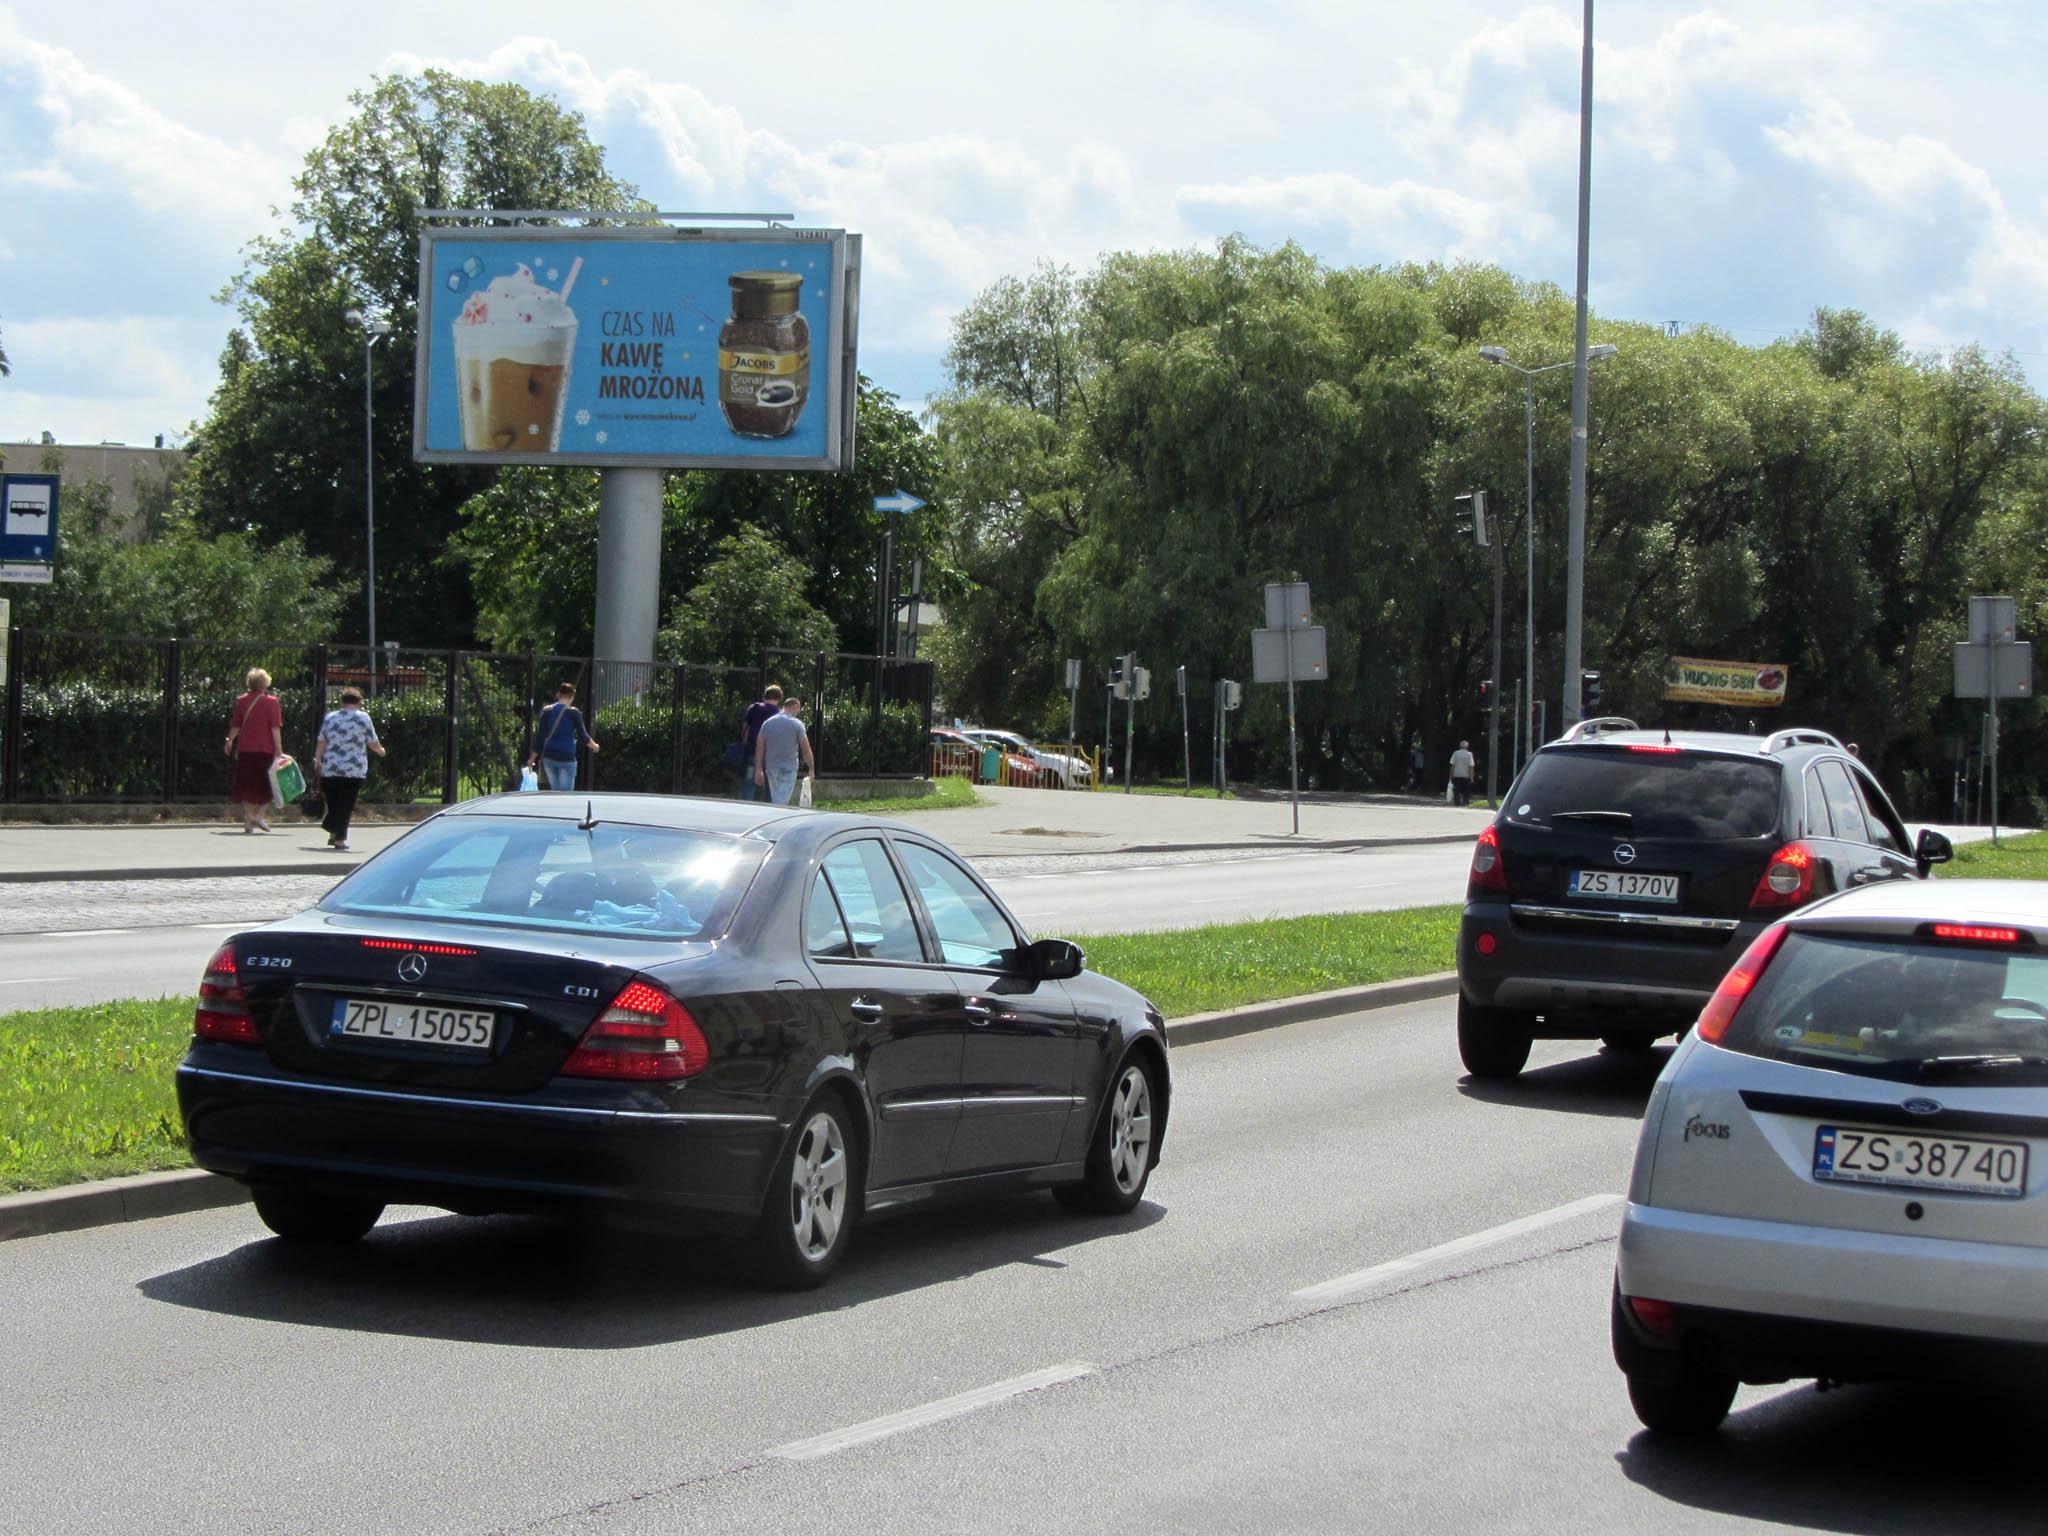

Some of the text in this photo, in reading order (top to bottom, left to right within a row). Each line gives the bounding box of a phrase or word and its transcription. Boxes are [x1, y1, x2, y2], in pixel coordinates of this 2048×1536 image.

[601, 311, 675, 337] CZAS NA
[600, 342, 663, 374] KAWĘ
[730, 356, 776, 369] JACOBS
[599, 368, 705, 406] MROŻONĄ
[731, 384, 754, 395] Gold
[1580, 873, 1675, 897] ZS 1370V
[246, 956, 293, 968] E 320
[564, 984, 599, 999] CDI
[345, 1003, 490, 1045] ZPL 15055
[1819, 1153, 1832, 1165] PL
[1839, 1134, 2016, 1184] ZS 38740
